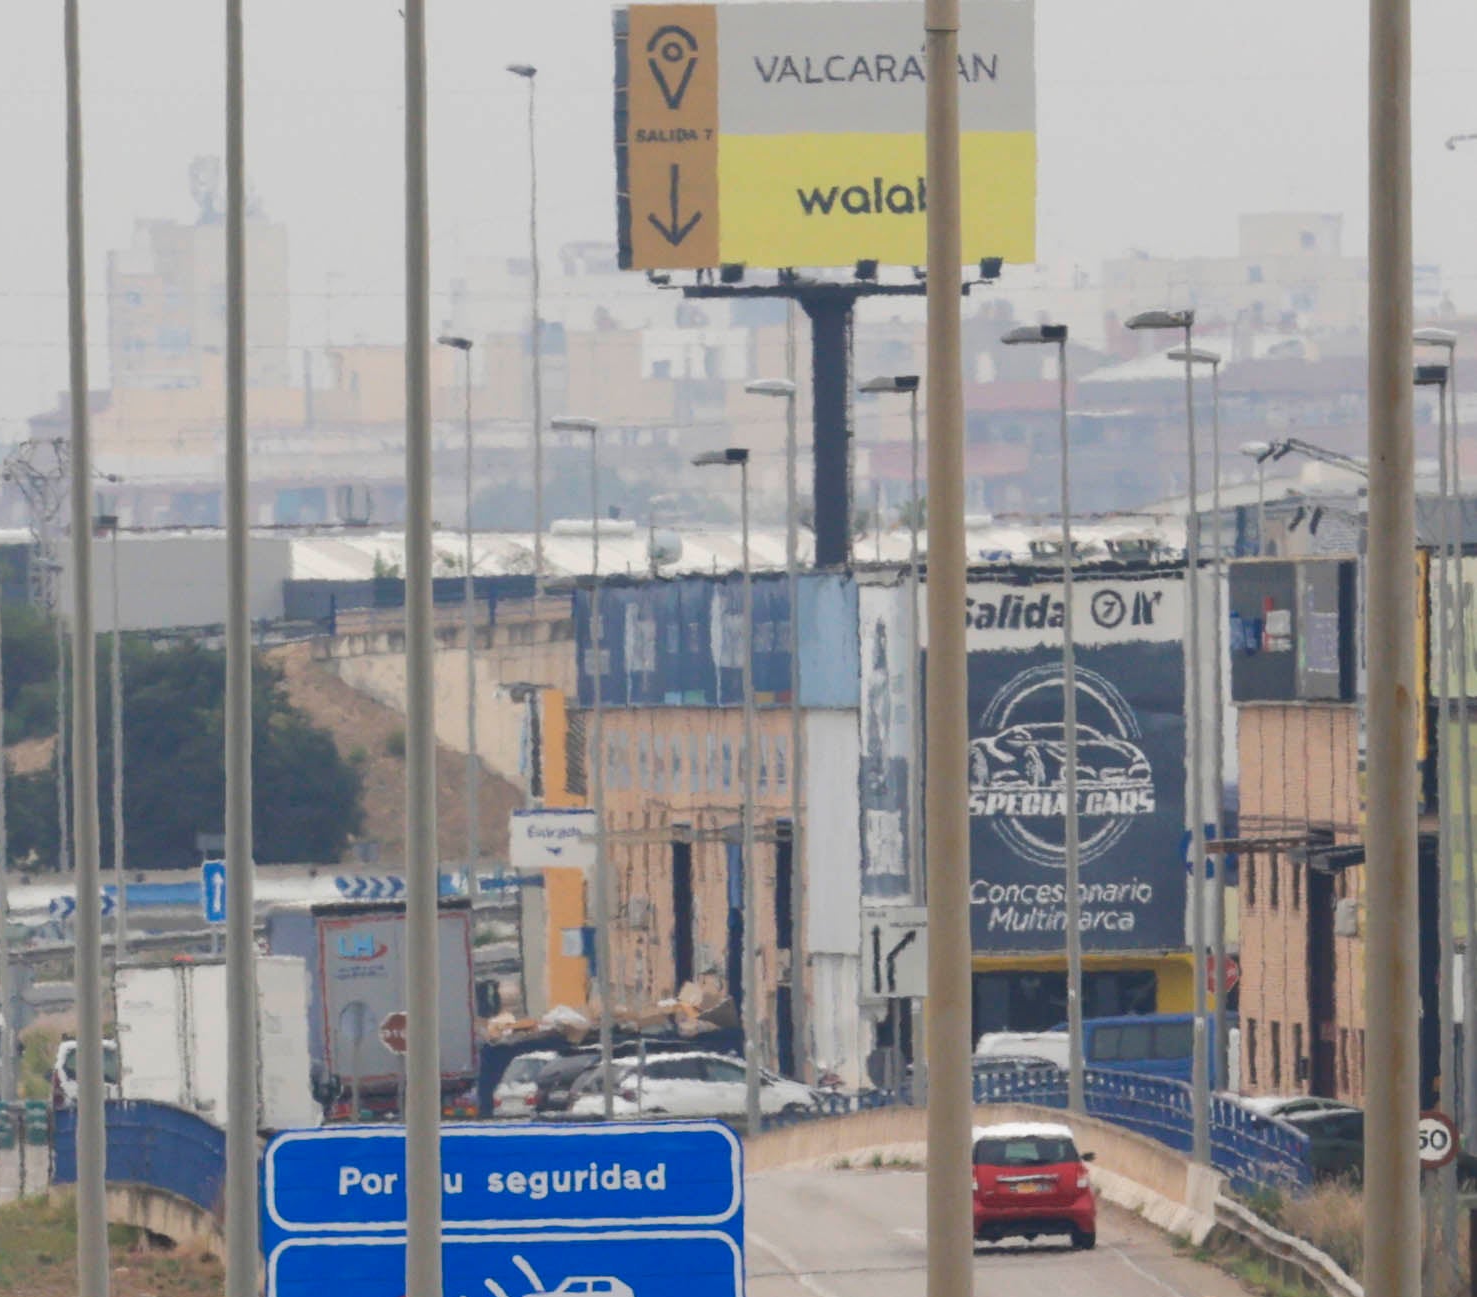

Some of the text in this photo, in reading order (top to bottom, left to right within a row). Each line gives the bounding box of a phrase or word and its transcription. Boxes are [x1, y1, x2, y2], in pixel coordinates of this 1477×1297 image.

[753, 53, 999, 84] VALCARAAN
[634, 128, 713, 144] SALIDA 7
[969, 790, 1156, 816] SPECIA CARS
[969, 877, 1153, 905] Concesonario
[339, 1162, 667, 1199] Por u seguridad
